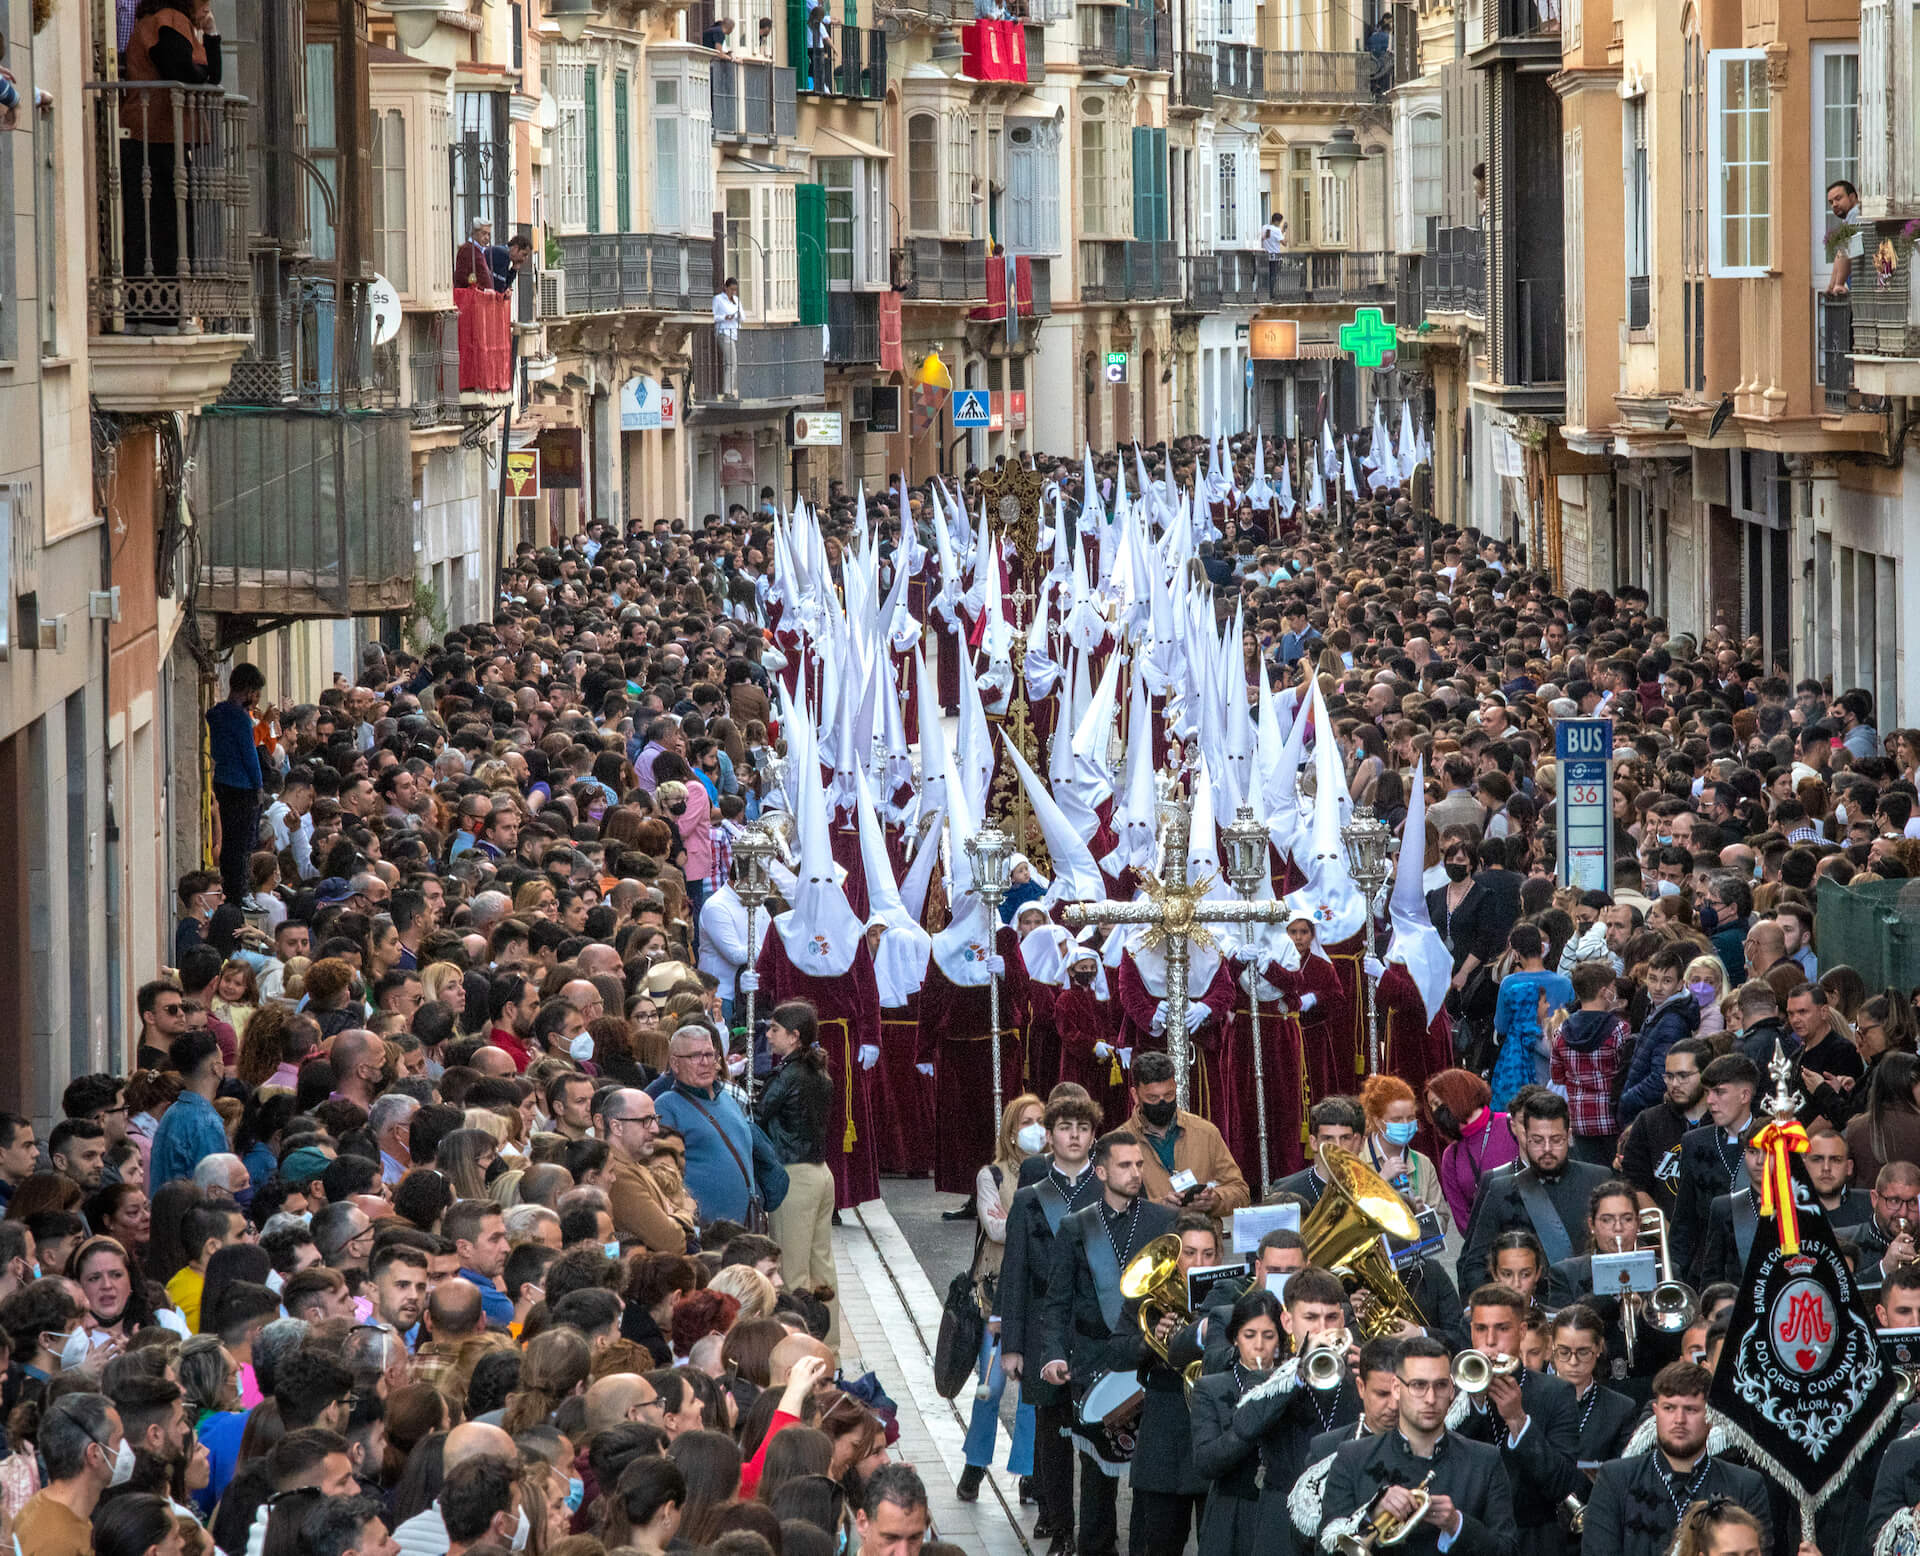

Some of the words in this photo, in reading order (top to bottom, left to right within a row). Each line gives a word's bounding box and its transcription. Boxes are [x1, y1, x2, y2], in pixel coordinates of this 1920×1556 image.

[1109, 354, 1126, 364] BIO
[1107, 364, 1122, 381] C
[1567, 728, 1602, 753] BUS
[1573, 785, 1598, 804] 36
[1768, 1240, 1820, 1262] COTAS
[1820, 1244, 1829, 1255] Y
[1760, 1261, 1774, 1276] DE
[1826, 1251, 1850, 1303] TAMBORES
[1754, 1279, 1767, 1313] BANDA
[1755, 1341, 1800, 1393] DOLORES
[1807, 1330, 1857, 1395] CORONADA
[1796, 1398, 1829, 1412] ÁLORA
